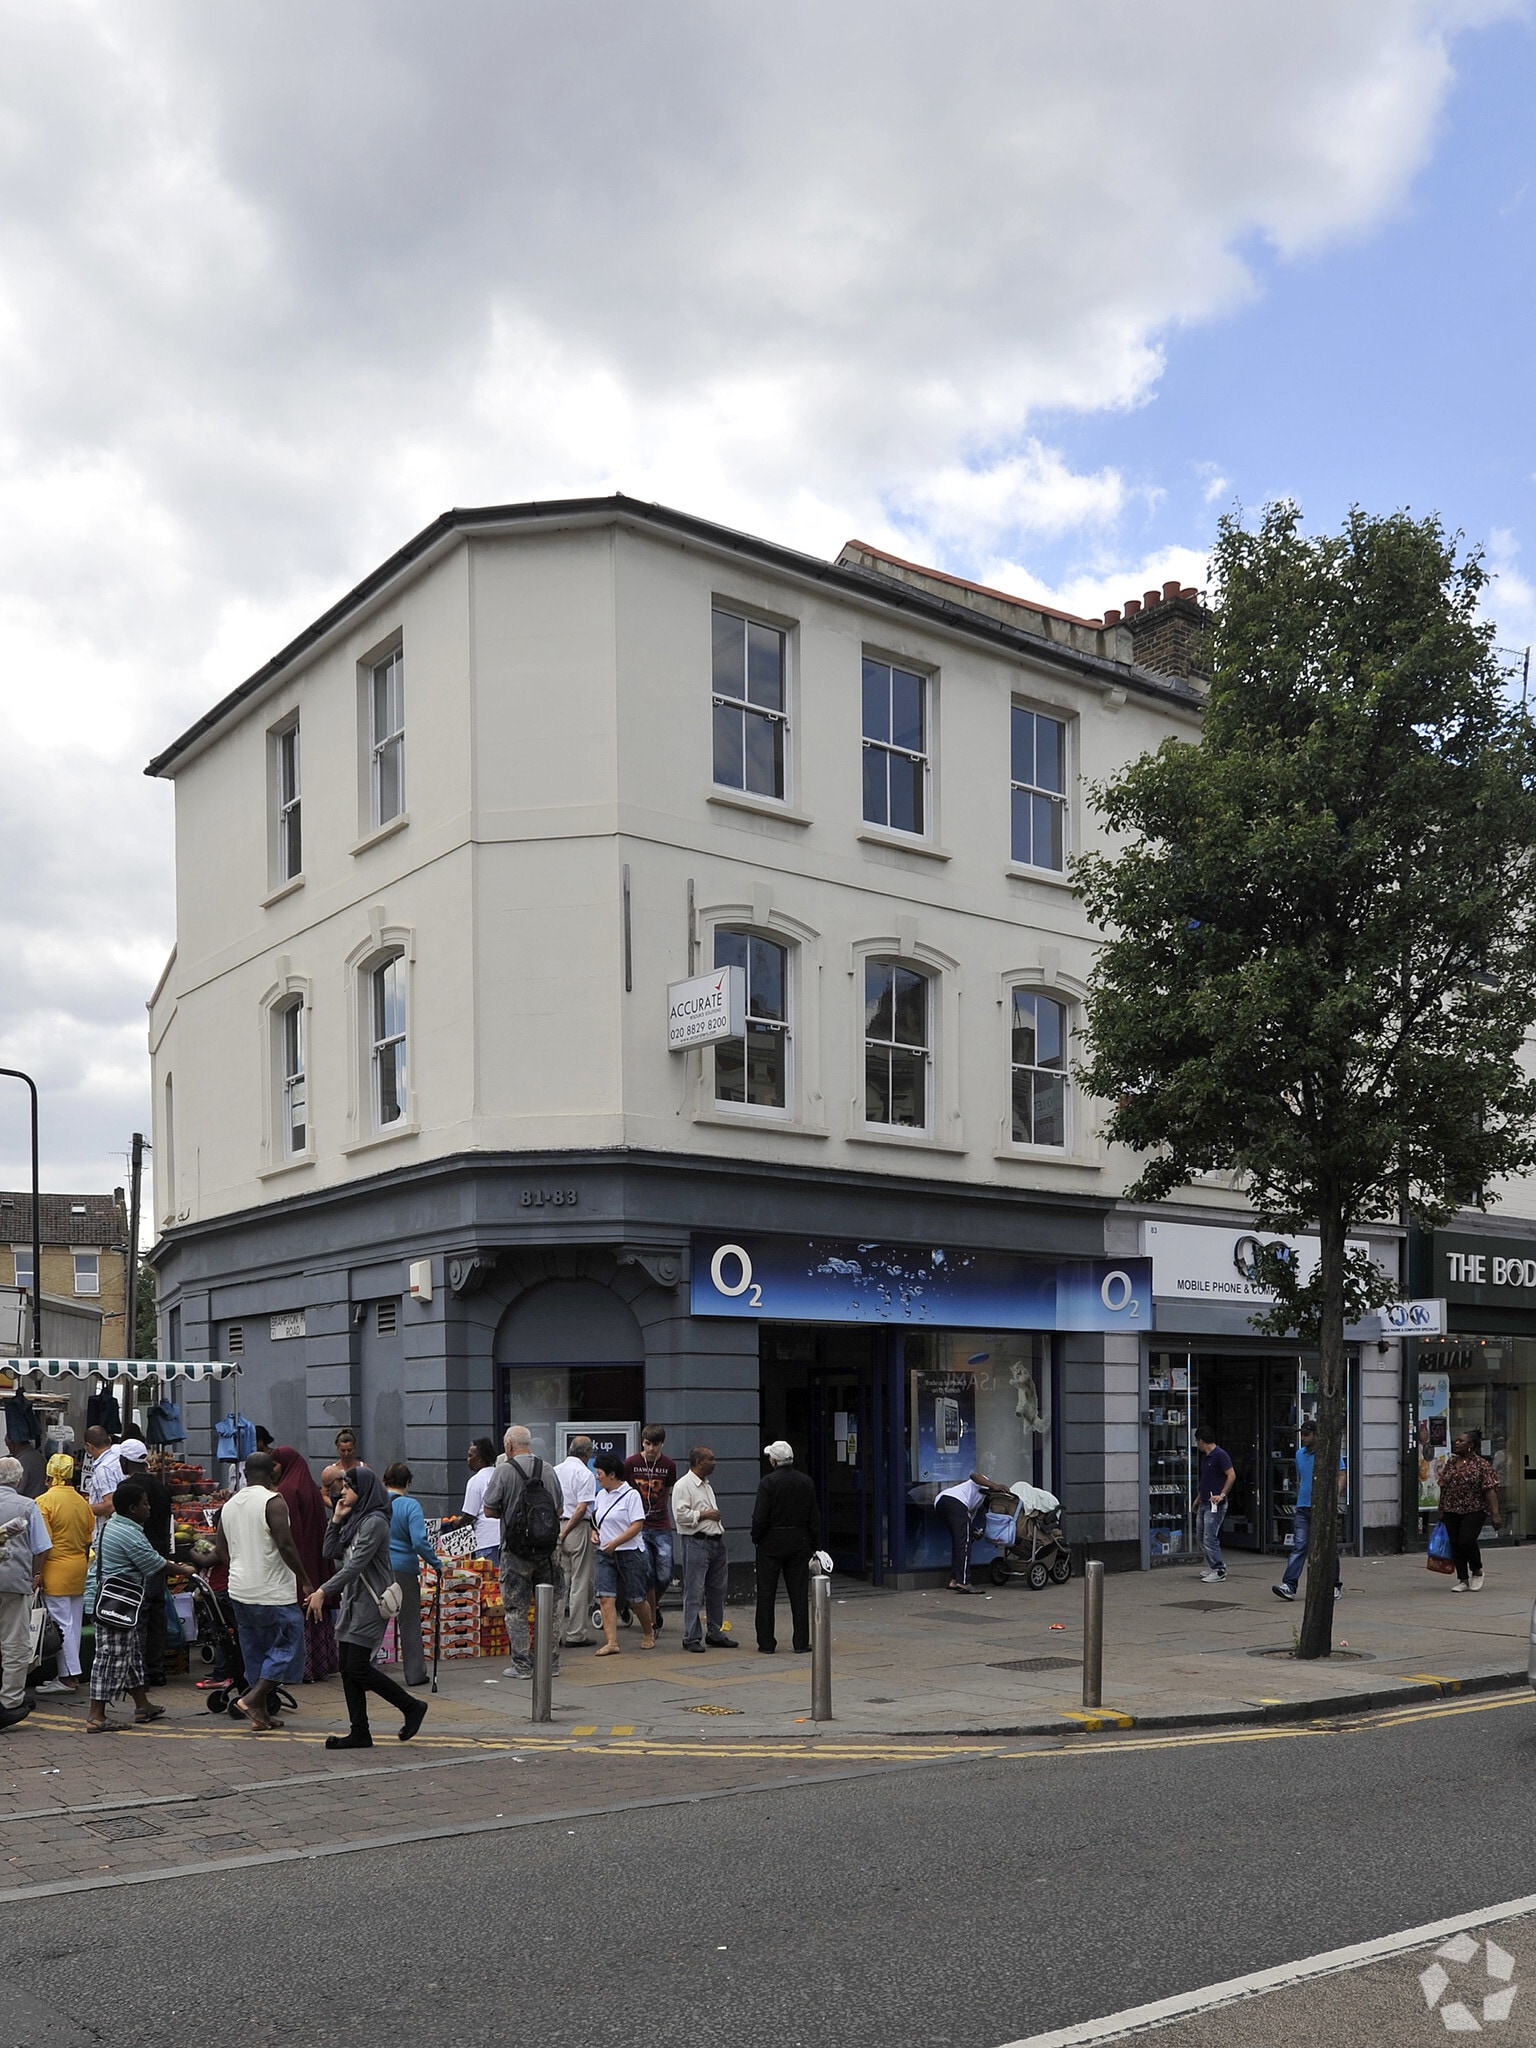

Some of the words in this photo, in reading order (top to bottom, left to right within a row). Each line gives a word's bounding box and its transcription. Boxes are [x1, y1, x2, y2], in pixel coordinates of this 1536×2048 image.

[670, 992, 722, 1020] ACCURATE
[670, 1027, 685, 1040] 020
[686, 1021, 706, 1036] 8829
[707, 1015, 727, 1030] 8200
[520, 1188, 578, 1207] 81-83
[1150, 1226, 1158, 1234] 83
[1446, 1252, 1487, 1284] THE
[1492, 1256, 1536, 1288] BOD
[1177, 1279, 1210, 1292] MOBILE
[1212, 1281, 1242, 1294] PHONE
[1243, 1284, 1250, 1294] &
[271, 1313, 299, 1328] BRAMPTON
[285, 1325, 301, 1337] ROAD
[600, 1441, 613, 1451] up
